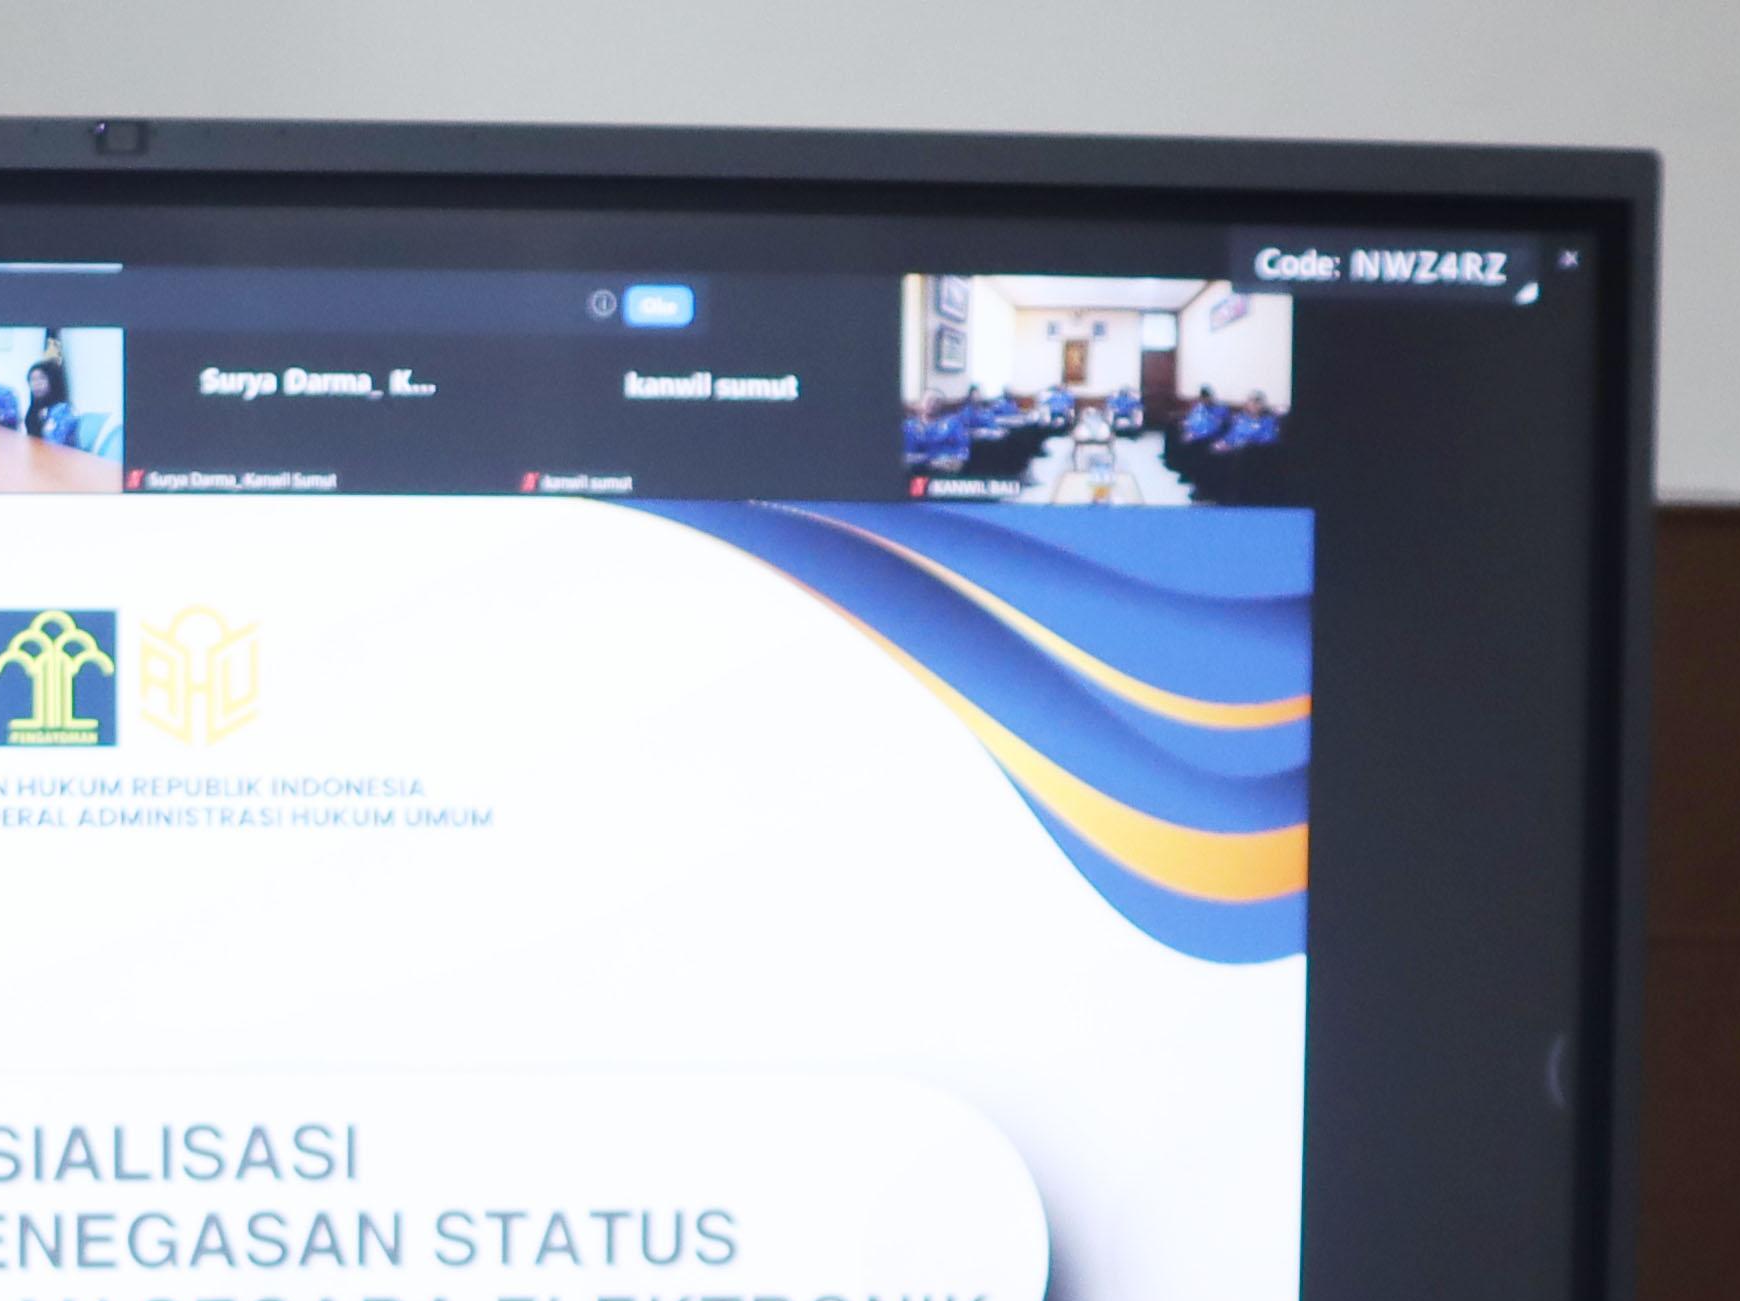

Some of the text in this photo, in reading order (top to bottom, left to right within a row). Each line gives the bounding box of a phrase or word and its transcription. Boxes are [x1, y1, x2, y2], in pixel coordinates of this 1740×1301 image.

[1255, 247, 1508, 283] Code: NWZ4RZ
[200, 367, 277, 399] Surya
[625, 371, 798, 400] kanwil sumut
[148, 471, 188, 491] Surya
[17, 776, 120, 799] HUKUM
[131, 776, 262, 798] REPUBLIK
[270, 776, 426, 798] INDONESIA
[78, 806, 283, 829] ADMINISTRASI
[291, 806, 396, 829] HUKUM
[405, 806, 494, 828] UMUM
[433, 1209, 740, 1269] STATUS
